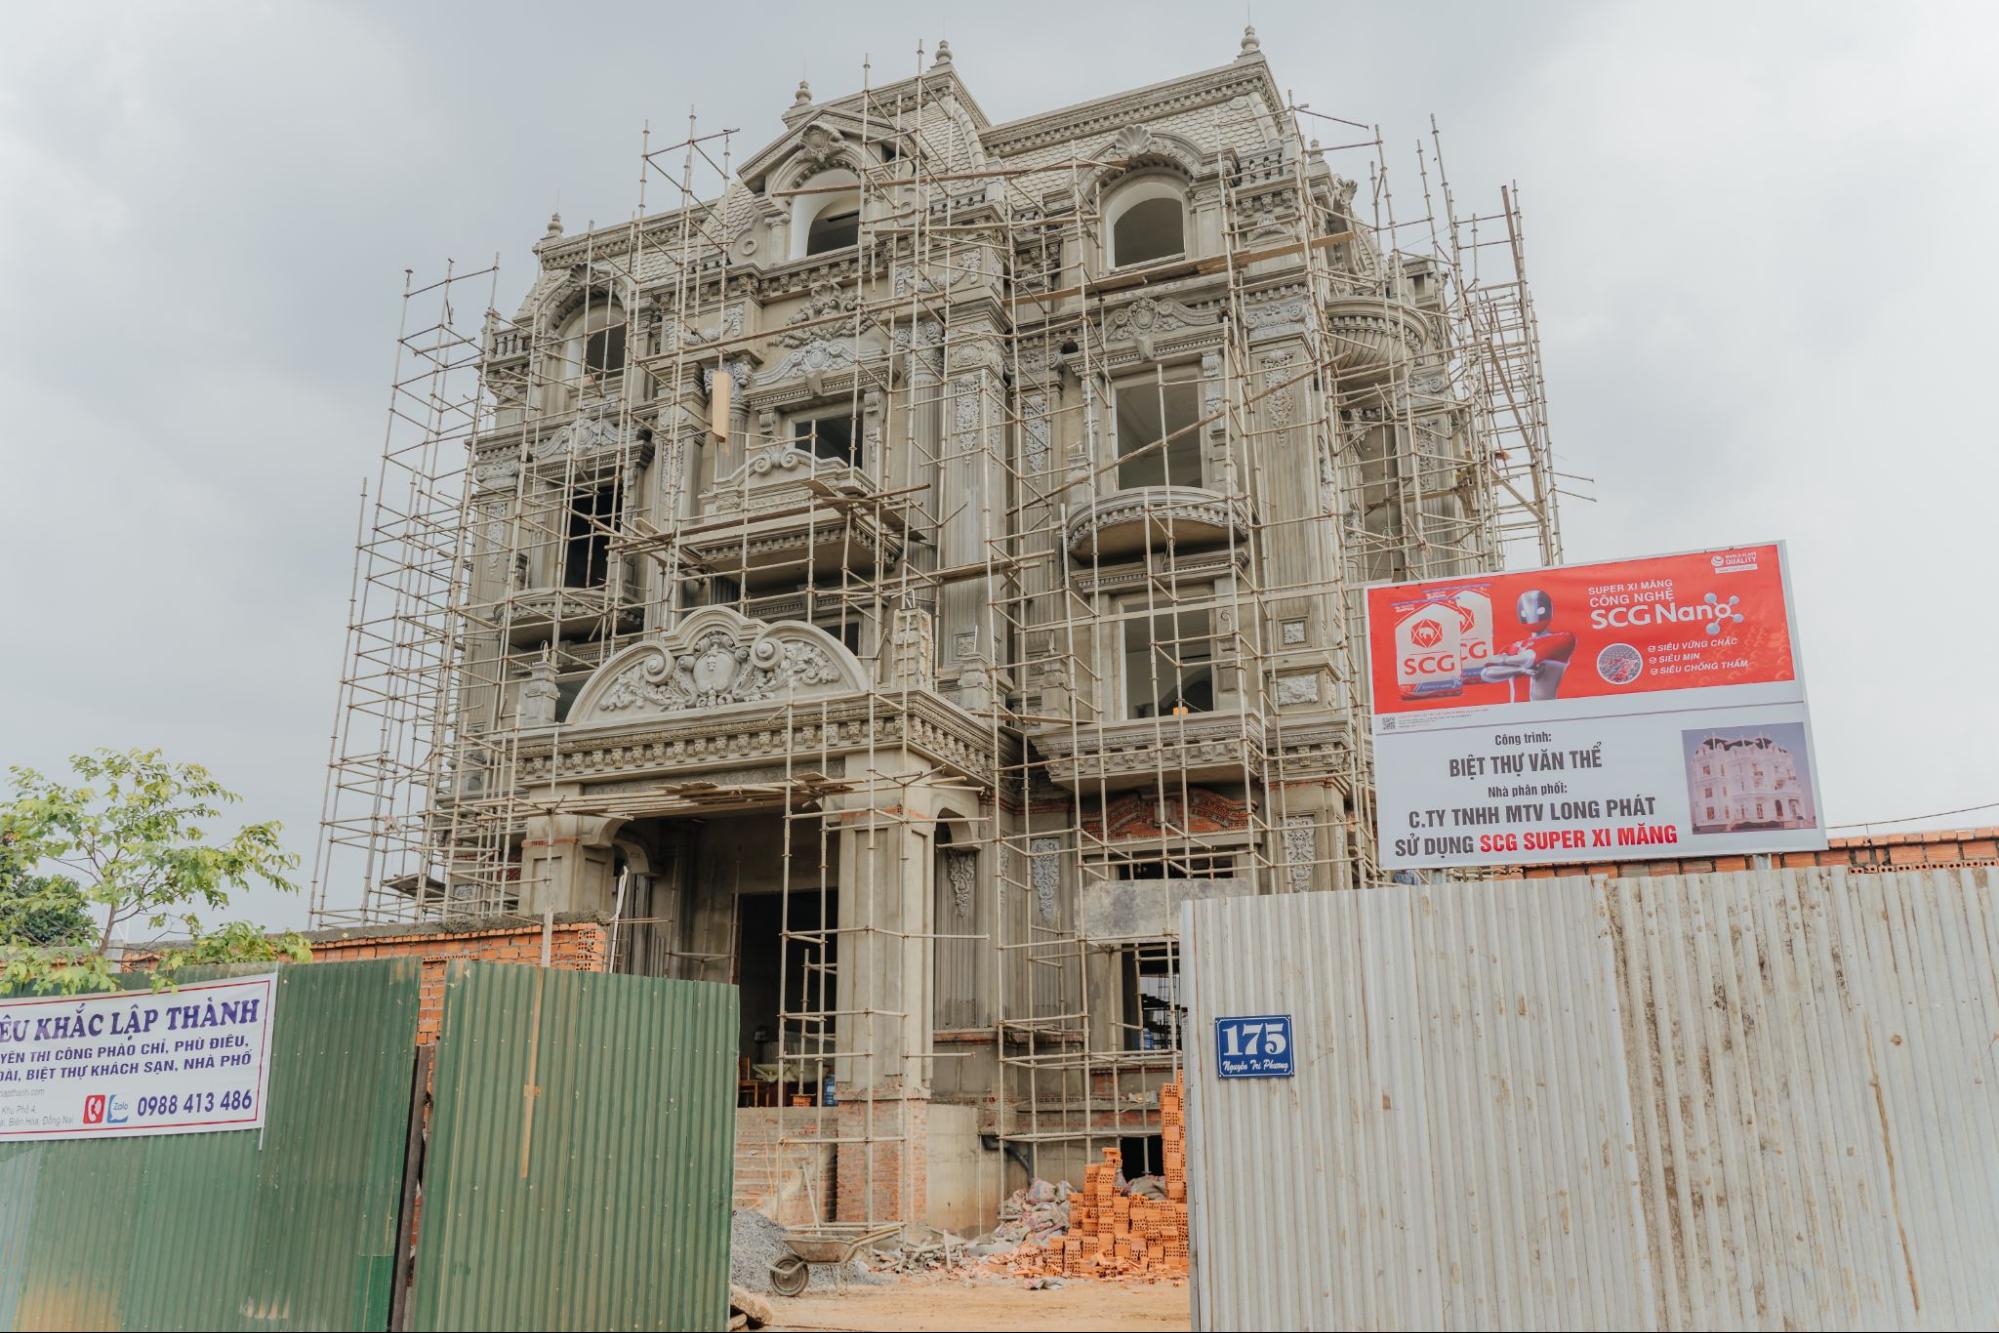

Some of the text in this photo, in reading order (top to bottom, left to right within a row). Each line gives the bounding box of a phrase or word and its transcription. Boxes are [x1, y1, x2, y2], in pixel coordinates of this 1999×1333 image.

[1588, 583, 1625, 595] SUPER
[1627, 581, 1638, 591] XI
[1589, 587, 1675, 608] CÔNG NGHỆ
[1657, 641, 1679, 652] SIÊU
[1403, 654, 1456, 676] SCG
[1658, 652, 1681, 664] SIÊU
[1659, 665, 1682, 676] SIÊU
[1494, 733, 1521, 746] Công
[1449, 741, 1602, 780] BIỆT THỰ VĂN THỂ
[1488, 781, 1568, 798] Nhà phân phối:
[1408, 794, 1656, 829] C.TY TNHH MTV LONG PHÁT
[1395, 822, 1678, 859] SỬ DỤNG SCG SUPER XI MĂNG
[34, 1002, 104, 1041] KHẮC
[110, 1003, 159, 1041] LẬP
[166, 996, 260, 1031] THÀNH
[30, 1050, 51, 1063] THI
[55, 1046, 93, 1061] CÔNG
[97, 1043, 136, 1058] PHÀO
[174, 1036, 205, 1052] PHÙ
[209, 1034, 249, 1050] ĐIÊU,
[1222, 1022, 1287, 1056] 175
[26, 1066, 56, 1082] BIỆT
[60, 1065, 88, 1080] THỰ
[91, 1061, 139, 1077] KHÁCH
[183, 1054, 215, 1070] NHÀ
[220, 1049, 253, 1067] PHỐ
[113, 1102, 129, 1111] Zalo
[137, 1089, 252, 1117] 0988 413 486
